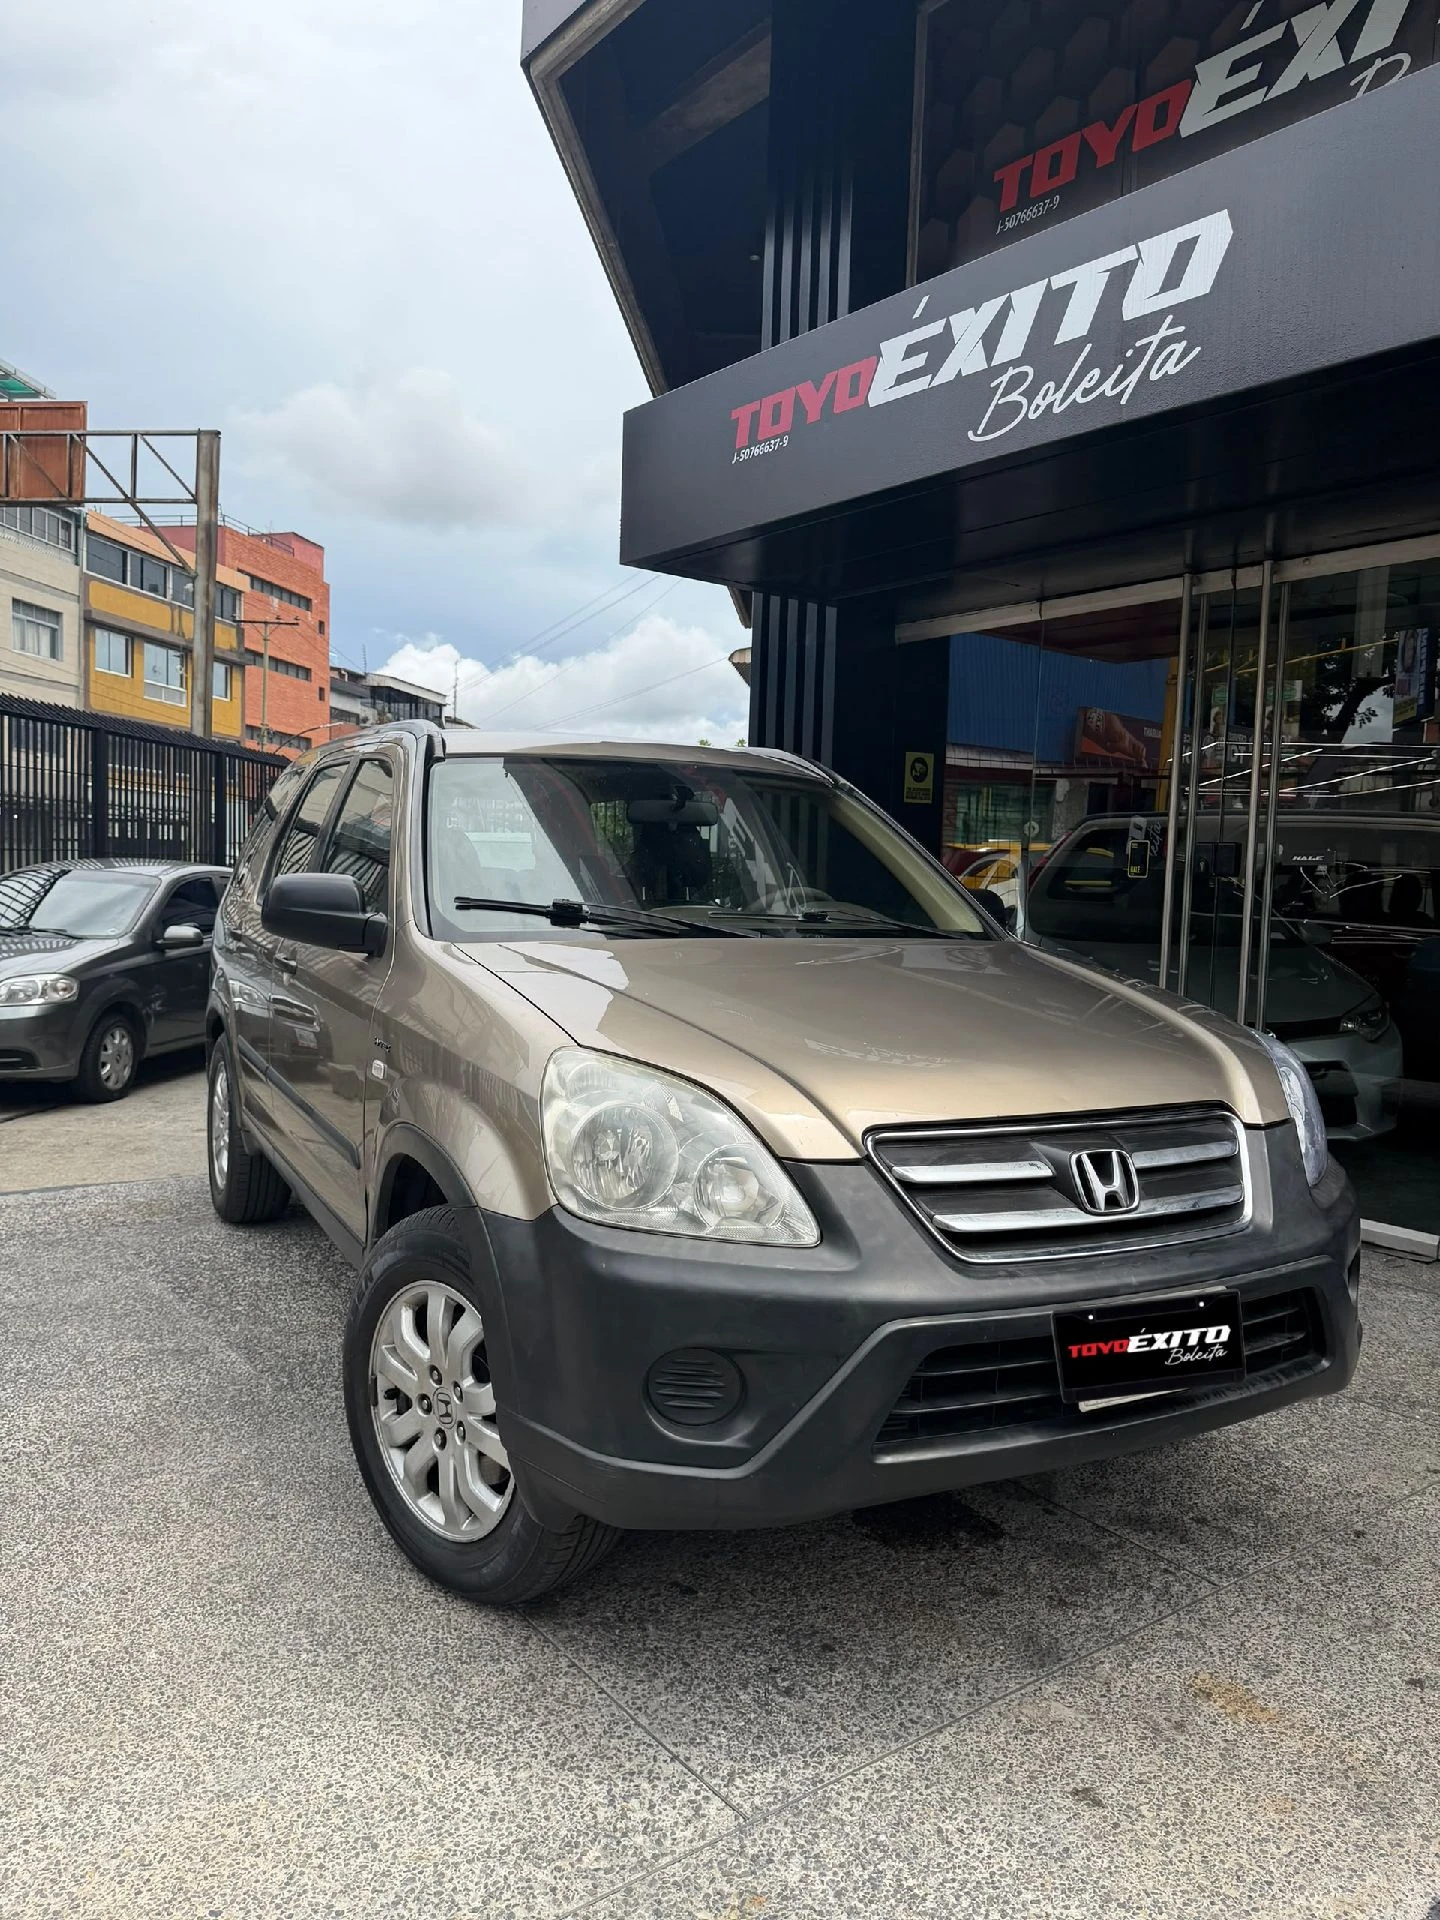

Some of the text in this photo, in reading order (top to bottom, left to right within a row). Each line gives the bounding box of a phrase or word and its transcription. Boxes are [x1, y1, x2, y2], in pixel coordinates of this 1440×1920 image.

[993, 0, 1440, 212] TOYOÉXI
[996, 195, 1060, 235] J-50766637-9
[967, 314, 1201, 442] Boleita
[731, 434, 789, 465] J-50766637-9
